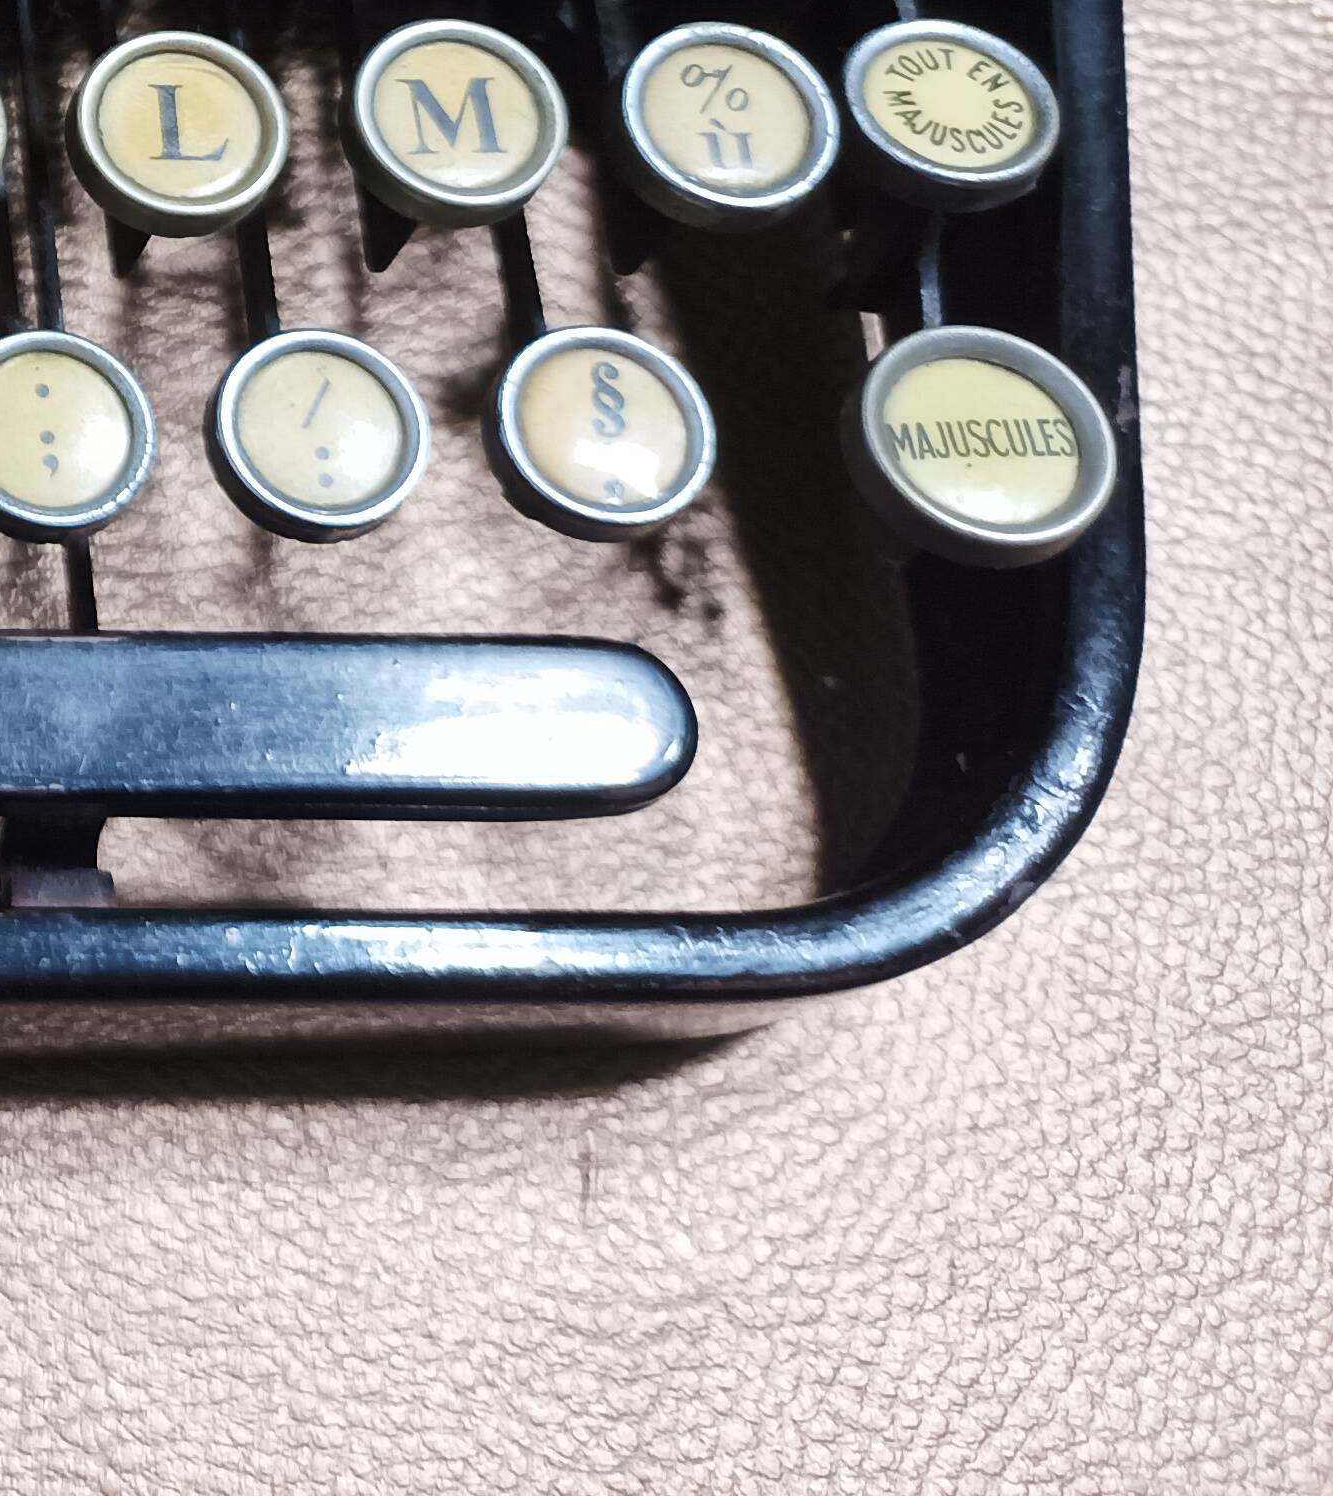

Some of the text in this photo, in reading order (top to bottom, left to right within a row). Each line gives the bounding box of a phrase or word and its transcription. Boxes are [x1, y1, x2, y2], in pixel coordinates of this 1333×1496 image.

[885, 48, 1010, 92] TOUT EN
[148, 84, 229, 161] L
[396, 78, 506, 154] M
[882, 90, 1024, 154] MAJUSCULES
[885, 418, 1078, 461] MAJUSCULES
